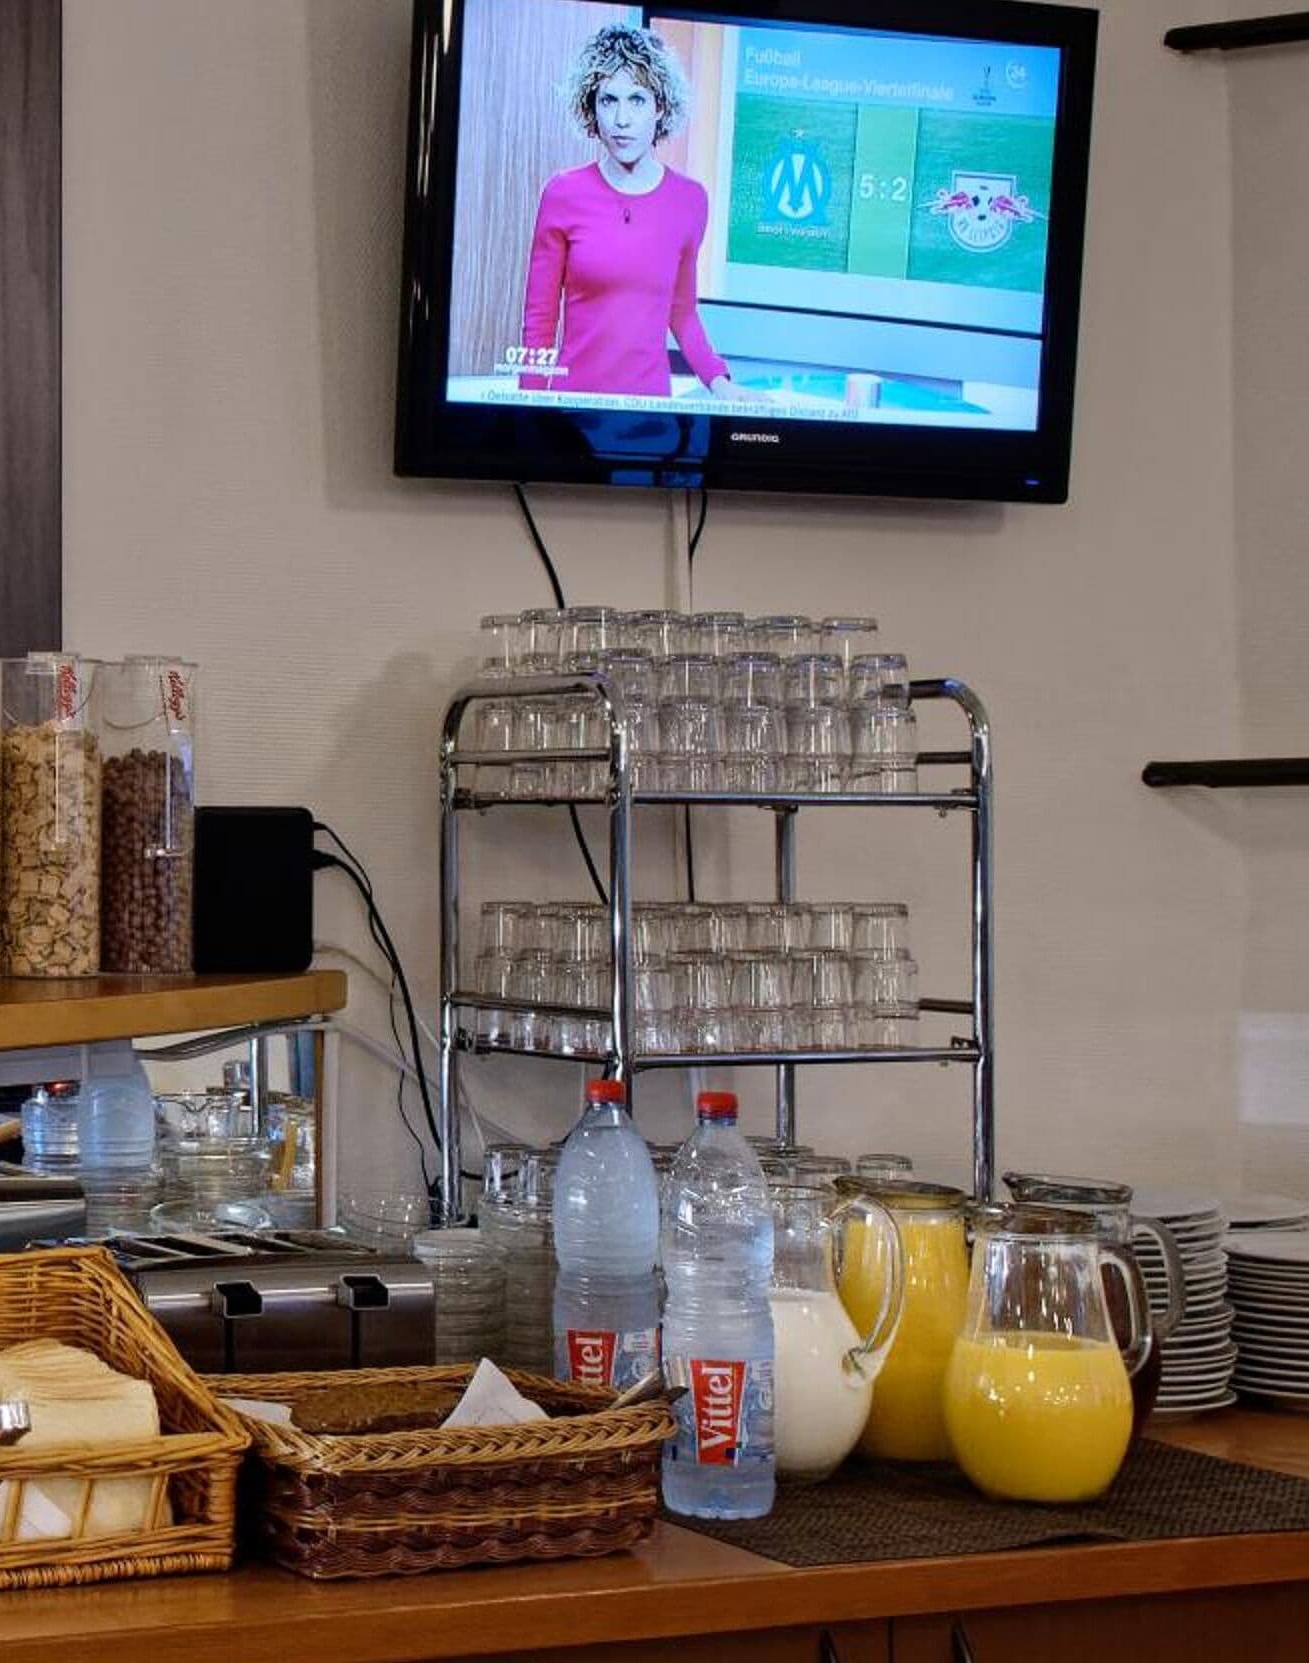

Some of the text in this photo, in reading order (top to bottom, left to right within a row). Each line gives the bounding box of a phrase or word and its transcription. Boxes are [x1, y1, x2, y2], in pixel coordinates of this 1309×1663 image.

[505, 346, 559, 365] 07:27
[730, 433, 780, 443] GRUNDIG
[575, 1336, 604, 1385] ttel
[701, 1361, 733, 1449] Vittel
